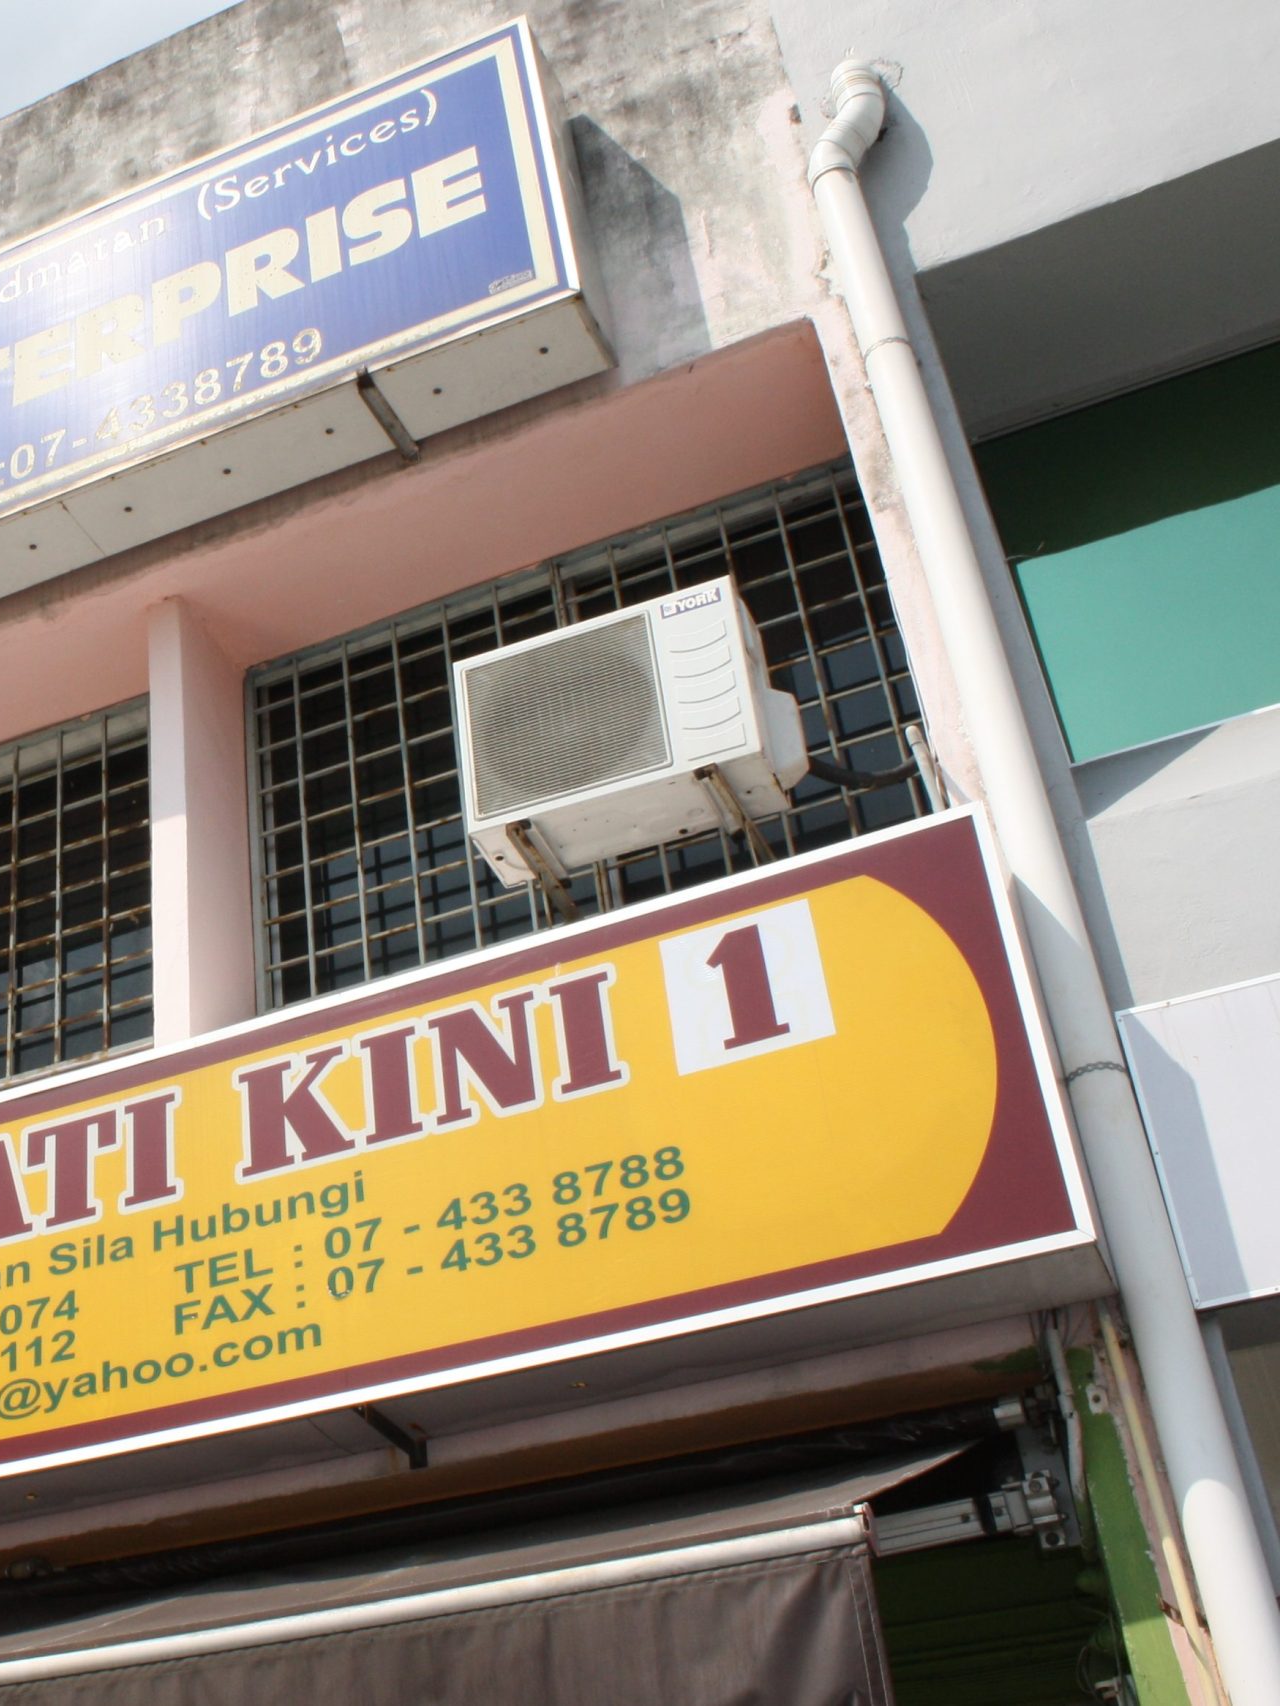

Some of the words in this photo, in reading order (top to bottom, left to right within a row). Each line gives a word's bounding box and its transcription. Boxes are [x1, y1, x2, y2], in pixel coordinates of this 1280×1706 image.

[197, 89, 439, 221] (Services)
[676, 588, 719, 612] YORK
[236, 965, 627, 1184] KINI
[706, 923, 790, 1050] 1
[48, 1235, 134, 1276] Sila
[154, 1170, 365, 1252] Hubungi
[174, 1248, 273, 1294] TEL
[324, 1217, 383, 1260] 07
[436, 1182, 533, 1232] 433
[552, 1145, 686, 1206] 8788
[174, 1283, 273, 1335] FAX
[327, 1258, 385, 1300] 07
[441, 1224, 536, 1273] 433
[556, 1188, 691, 1248] 8789
